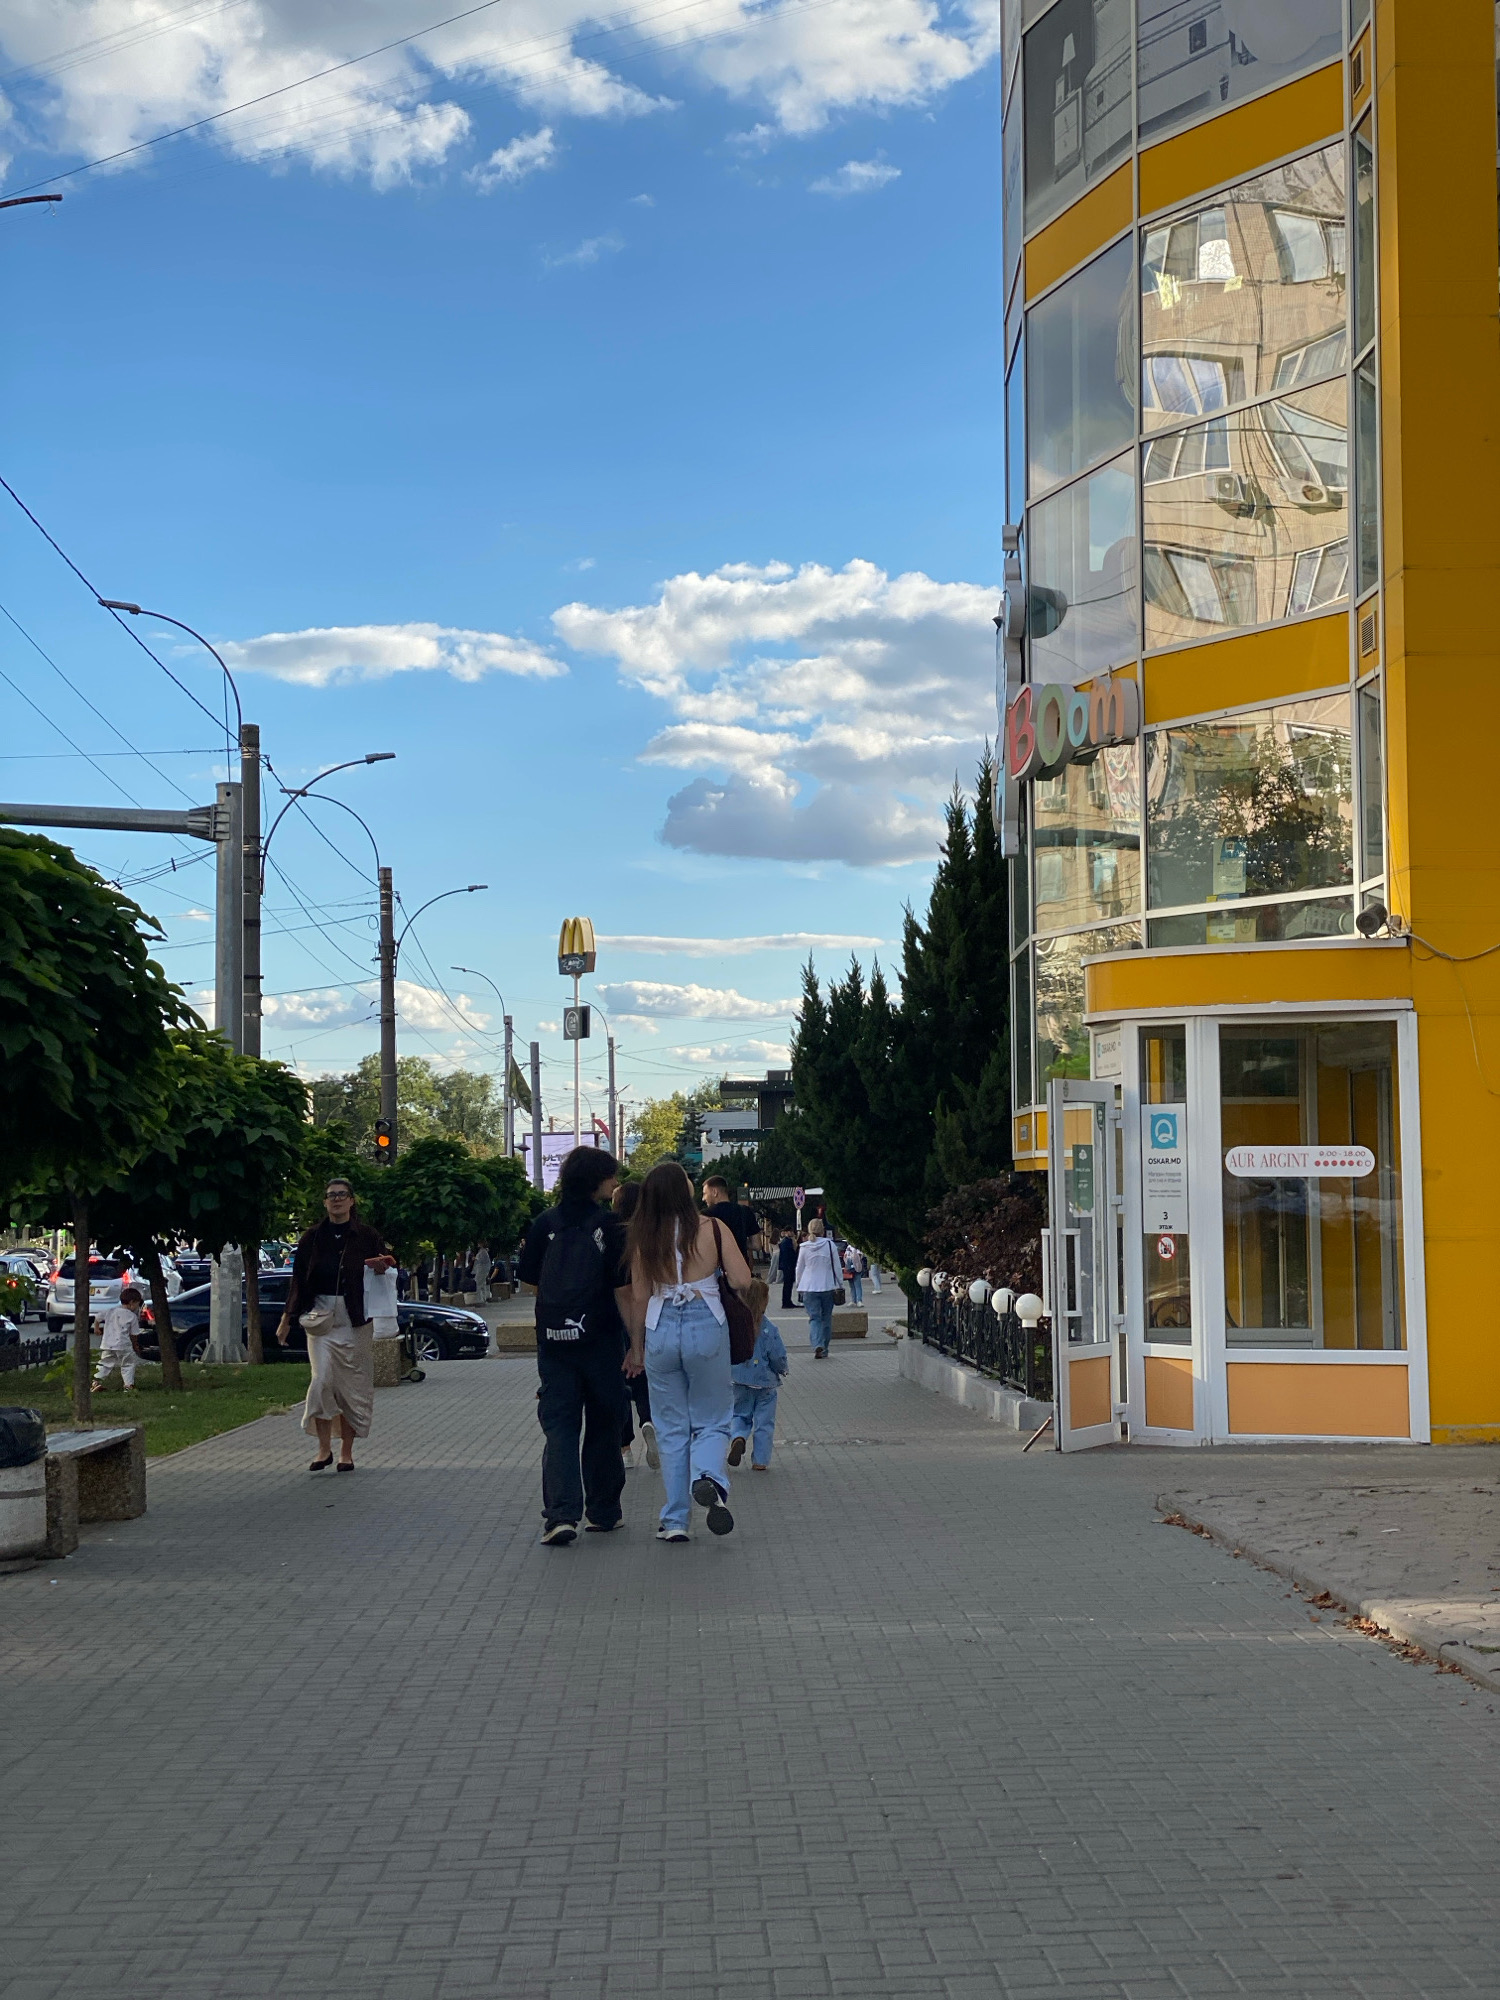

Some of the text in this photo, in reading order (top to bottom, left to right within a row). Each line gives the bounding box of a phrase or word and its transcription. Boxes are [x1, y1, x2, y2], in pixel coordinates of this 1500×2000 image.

[1148, 1157, 1182, 1165] OSKAR.MD
[1229, 1152, 1309, 1168] AUR ARGINT
[1163, 1211, 1168, 1220] 3
[546, 1327, 579, 1341] PUMA
